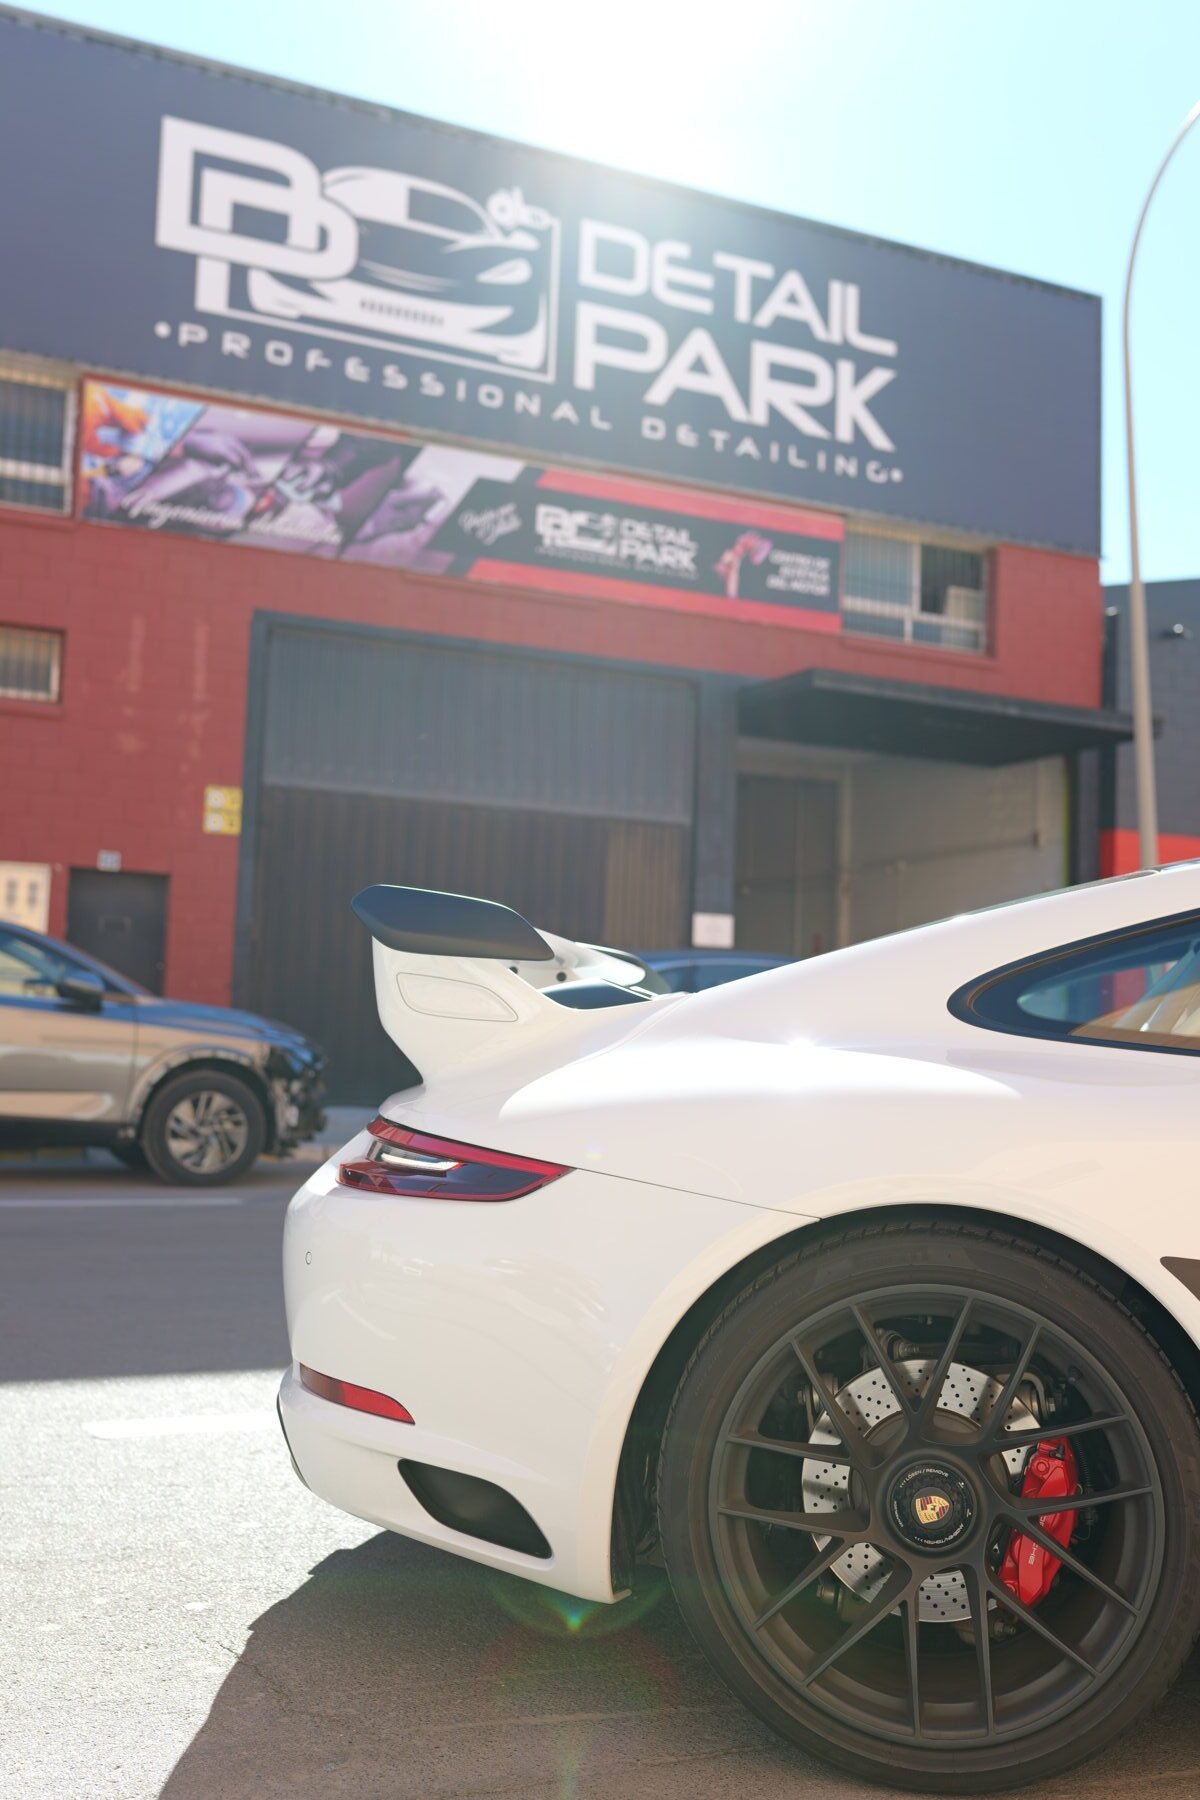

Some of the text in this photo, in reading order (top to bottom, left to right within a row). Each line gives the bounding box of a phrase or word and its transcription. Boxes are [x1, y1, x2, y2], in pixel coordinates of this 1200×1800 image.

[578, 217, 898, 357] DETAIL
[178, 321, 890, 484] PROFESSIONAL DETAILING
[574, 300, 896, 453] PARK
[619, 538, 698, 572] PARK
[620, 517, 699, 550] DETAIL
